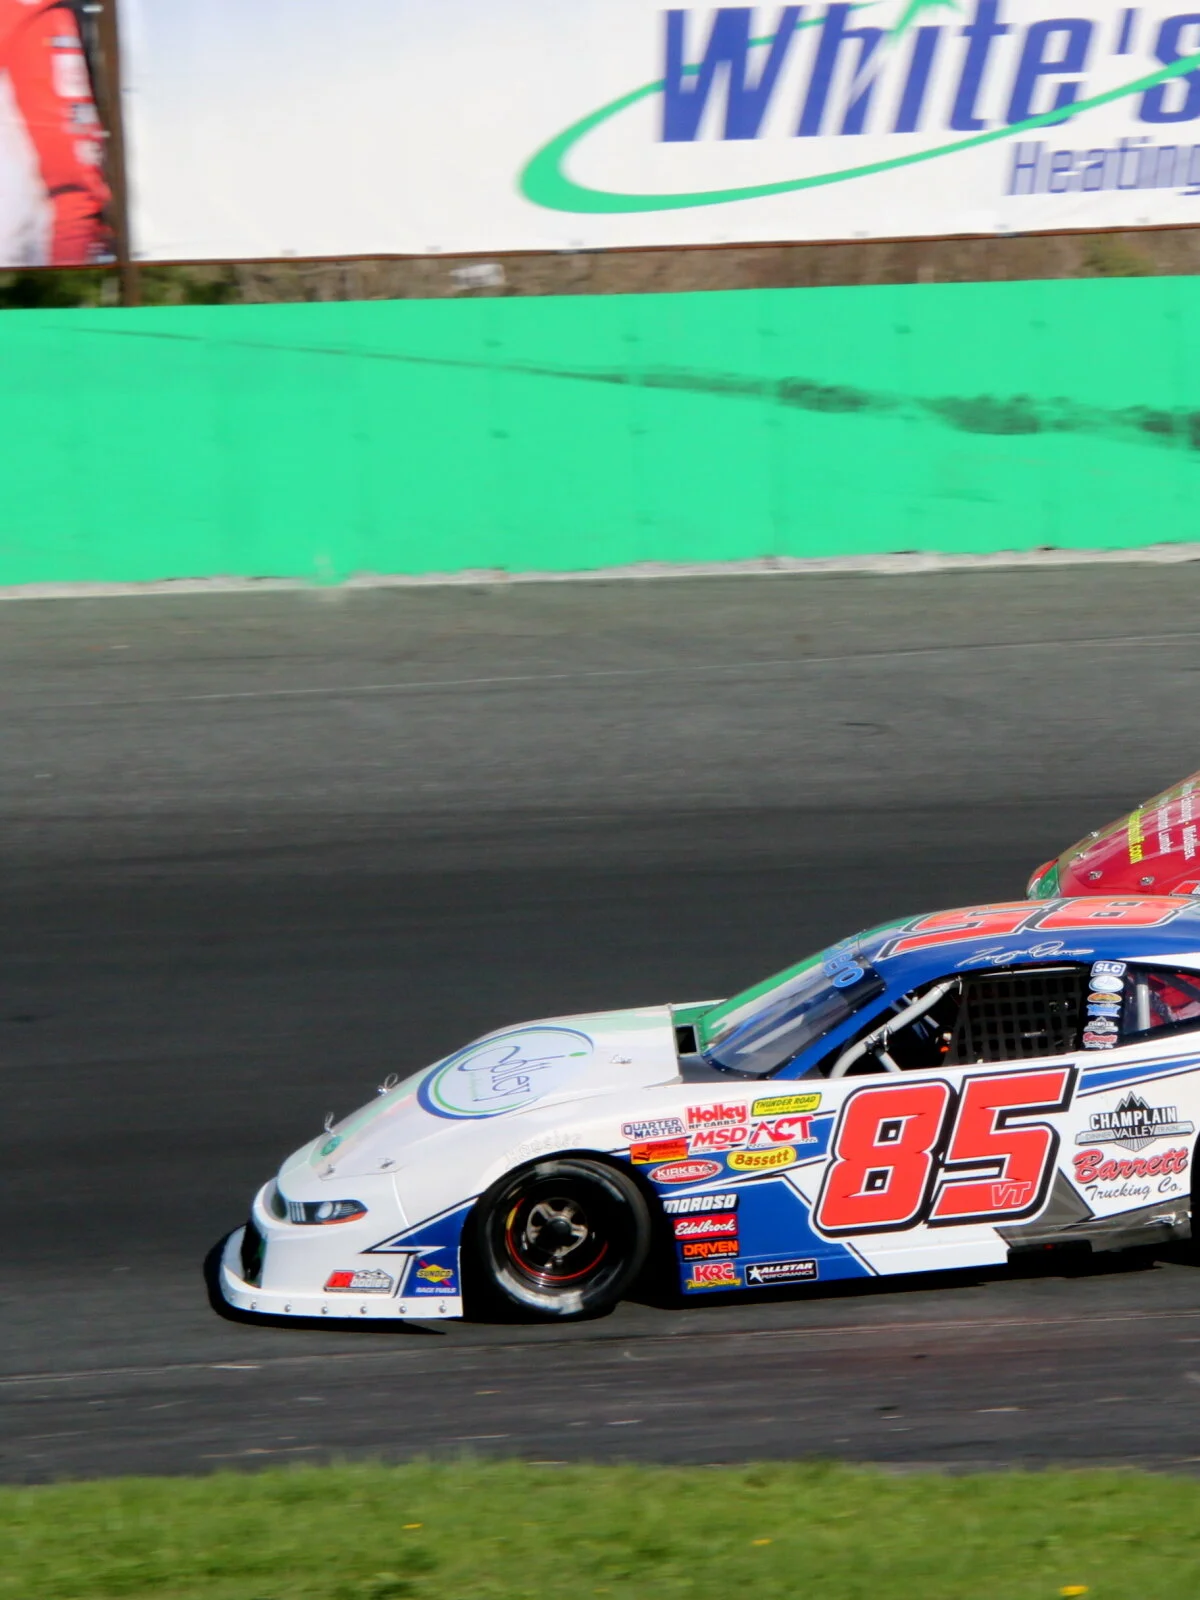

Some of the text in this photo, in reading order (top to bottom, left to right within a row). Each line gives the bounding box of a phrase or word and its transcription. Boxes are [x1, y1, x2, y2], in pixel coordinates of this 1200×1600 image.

[1094, 962, 1122, 974] SLC
[756, 1096, 817, 1108] THUNDER ROAD
[687, 1103, 747, 1125] Holley
[1090, 1107, 1177, 1130] CHAMPLAIN
[623, 1118, 679, 1136] QUARTER
[634, 1126, 683, 1139] MASTER
[1113, 1125, 1156, 1139] VALLEY
[692, 1126, 748, 1148] MSD
[734, 1149, 790, 1167] Bassett
[813, 1064, 1079, 1238] 85
[655, 1164, 706, 1177] KIRKEY
[1072, 1146, 1189, 1185] Barrett
[992, 1182, 1033, 1208] VT
[1085, 1176, 1182, 1201] Trucking Co.
[663, 1194, 737, 1214] MOROSO
[674, 1218, 736, 1236] Edelbrock
[683, 1240, 738, 1258] DRIVEN
[417, 1269, 453, 1278] SUNOCO
[693, 1263, 736, 1282] KRC
[760, 1262, 814, 1274] ALLSTAR
[761, 1270, 815, 1279] PERFORMANCE
